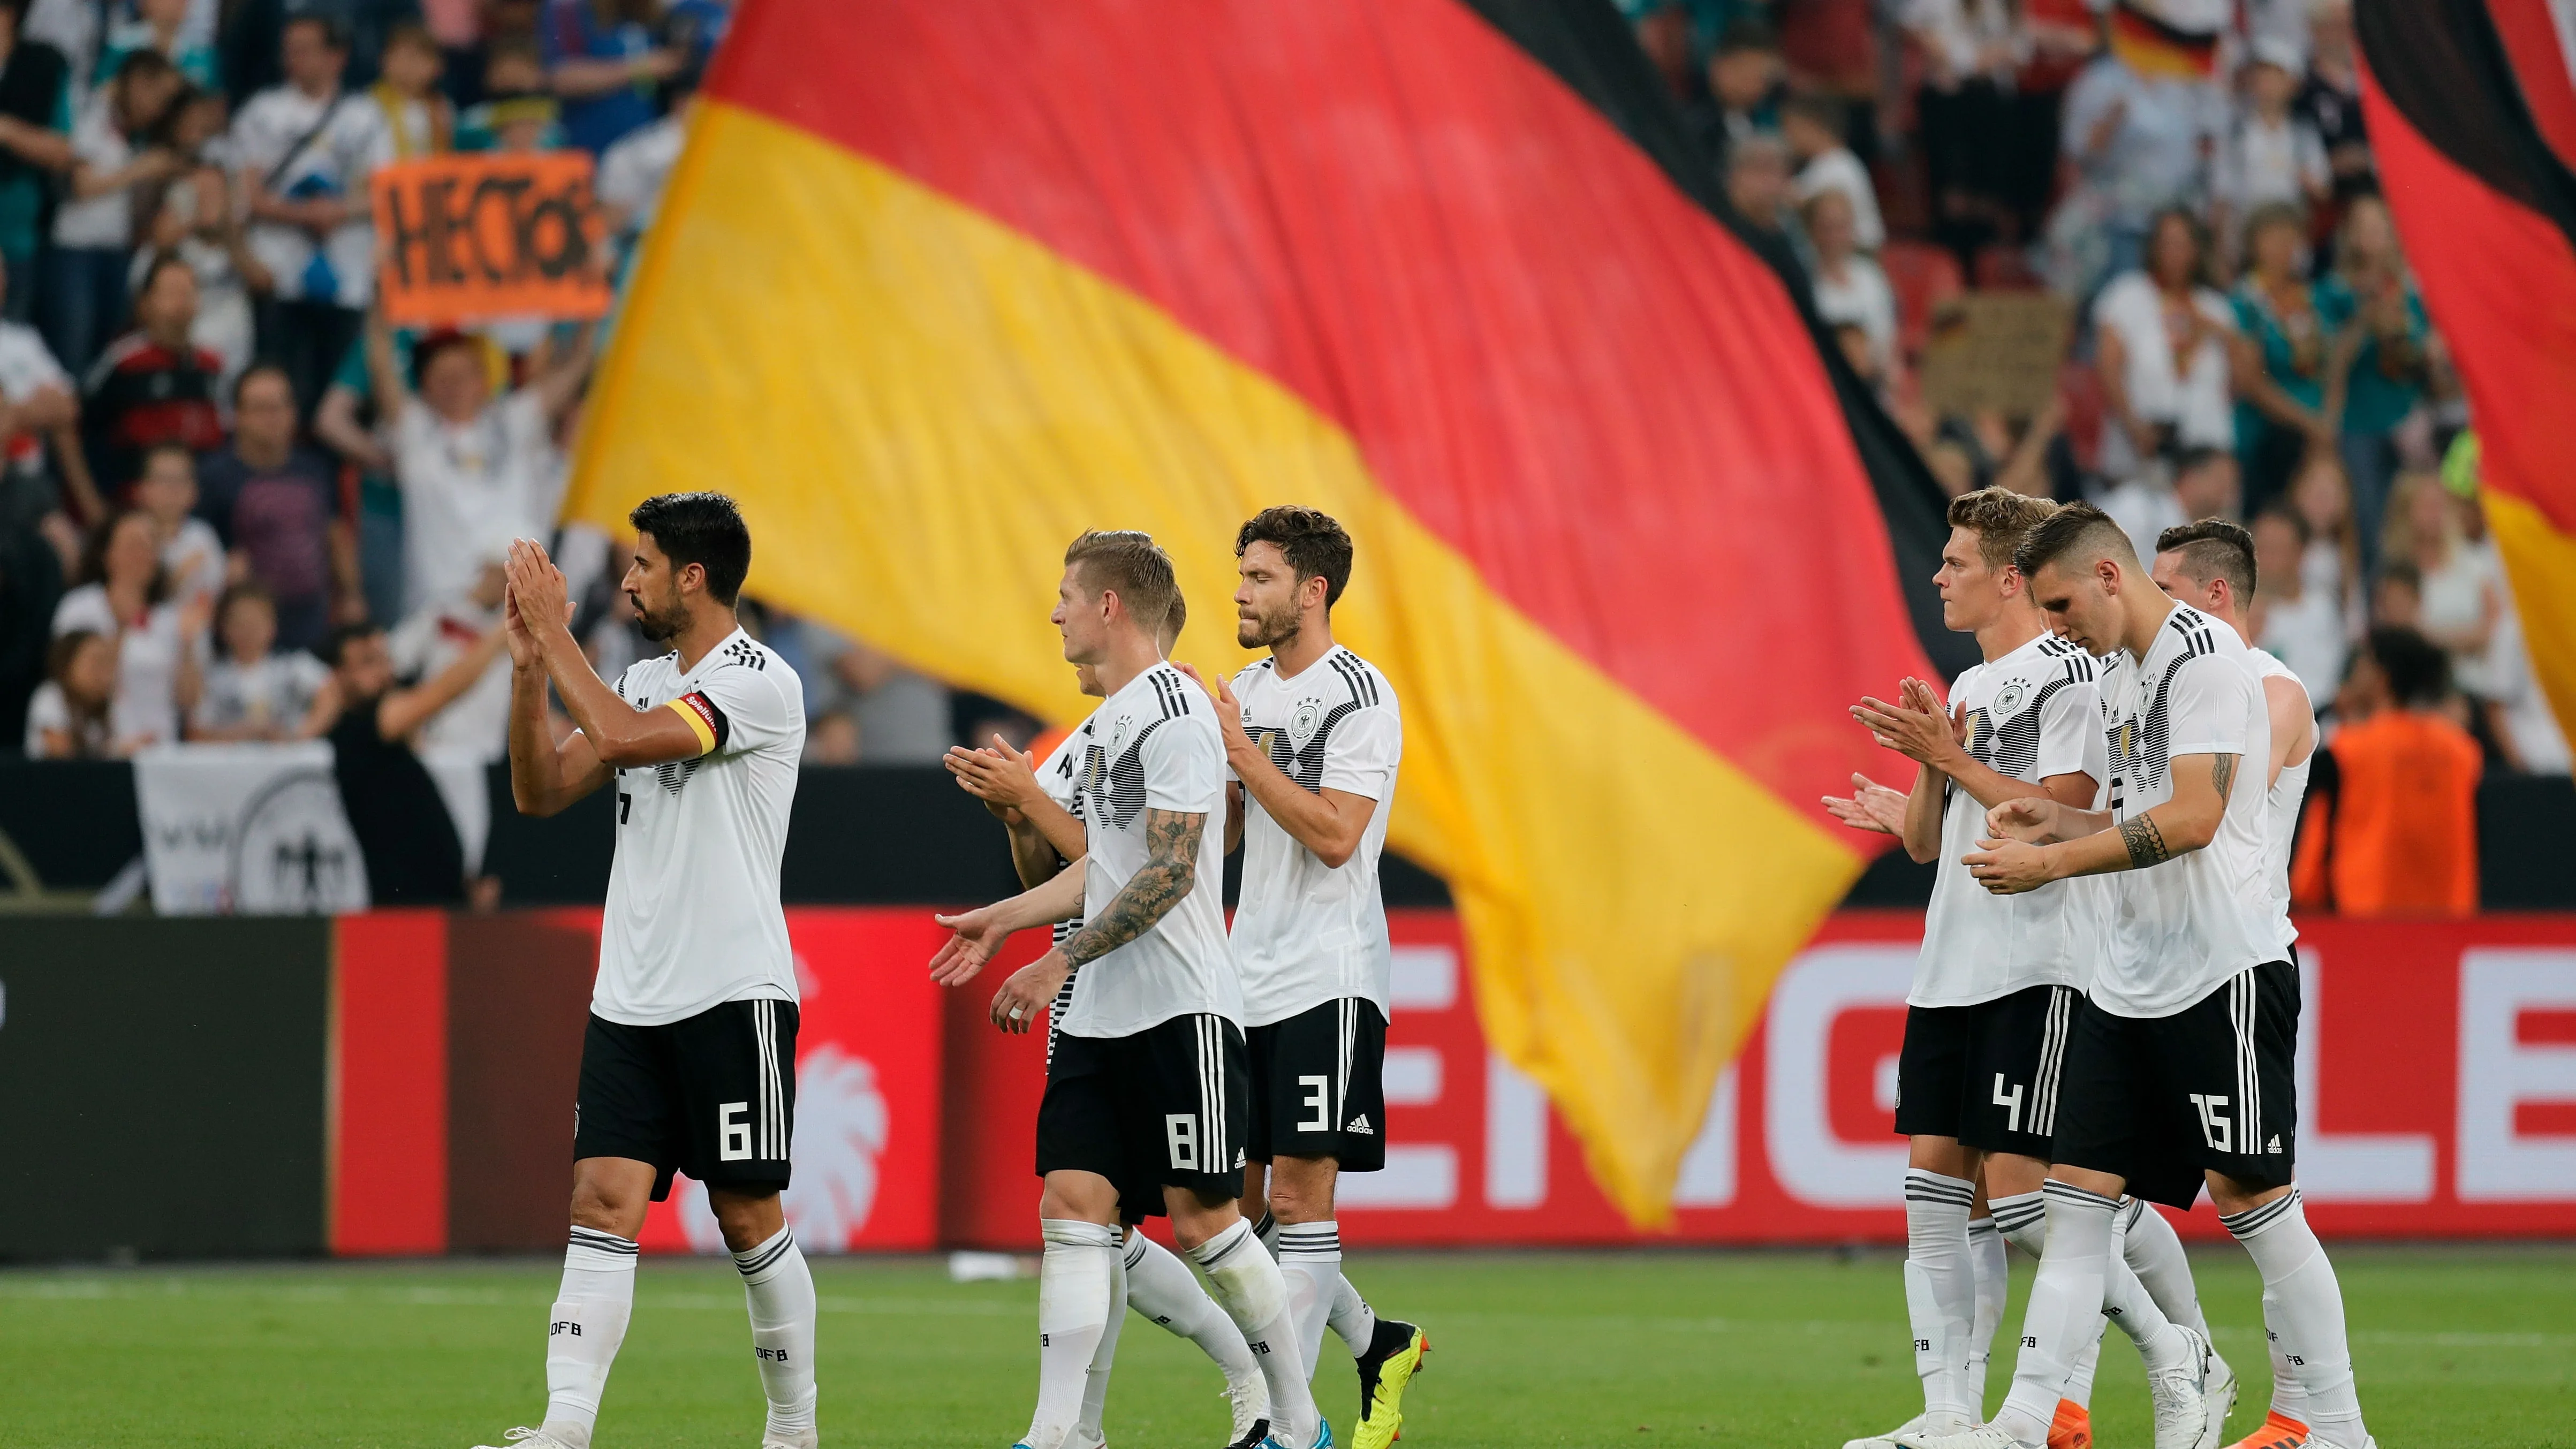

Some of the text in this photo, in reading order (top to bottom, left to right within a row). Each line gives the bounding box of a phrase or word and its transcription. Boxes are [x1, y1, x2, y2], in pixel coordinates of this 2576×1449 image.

[1297, 1075, 1328, 1132] 3
[1992, 1073, 2023, 1132] 4
[1347, 1125, 1374, 1135] adidas
[2189, 1094, 2231, 1152] 15
[719, 1102, 752, 1161] 6
[1166, 1114, 1198, 1170] 8
[550, 1321, 582, 1337] DFB
[2265, 1327, 2278, 1342] DF
[1247, 1340, 1271, 1355] FB
[1914, 1339, 1929, 1352] FB
[2020, 1336, 2036, 1348] FB
[755, 1346, 788, 1362] DFB
[2285, 1353, 2305, 1365] FB
